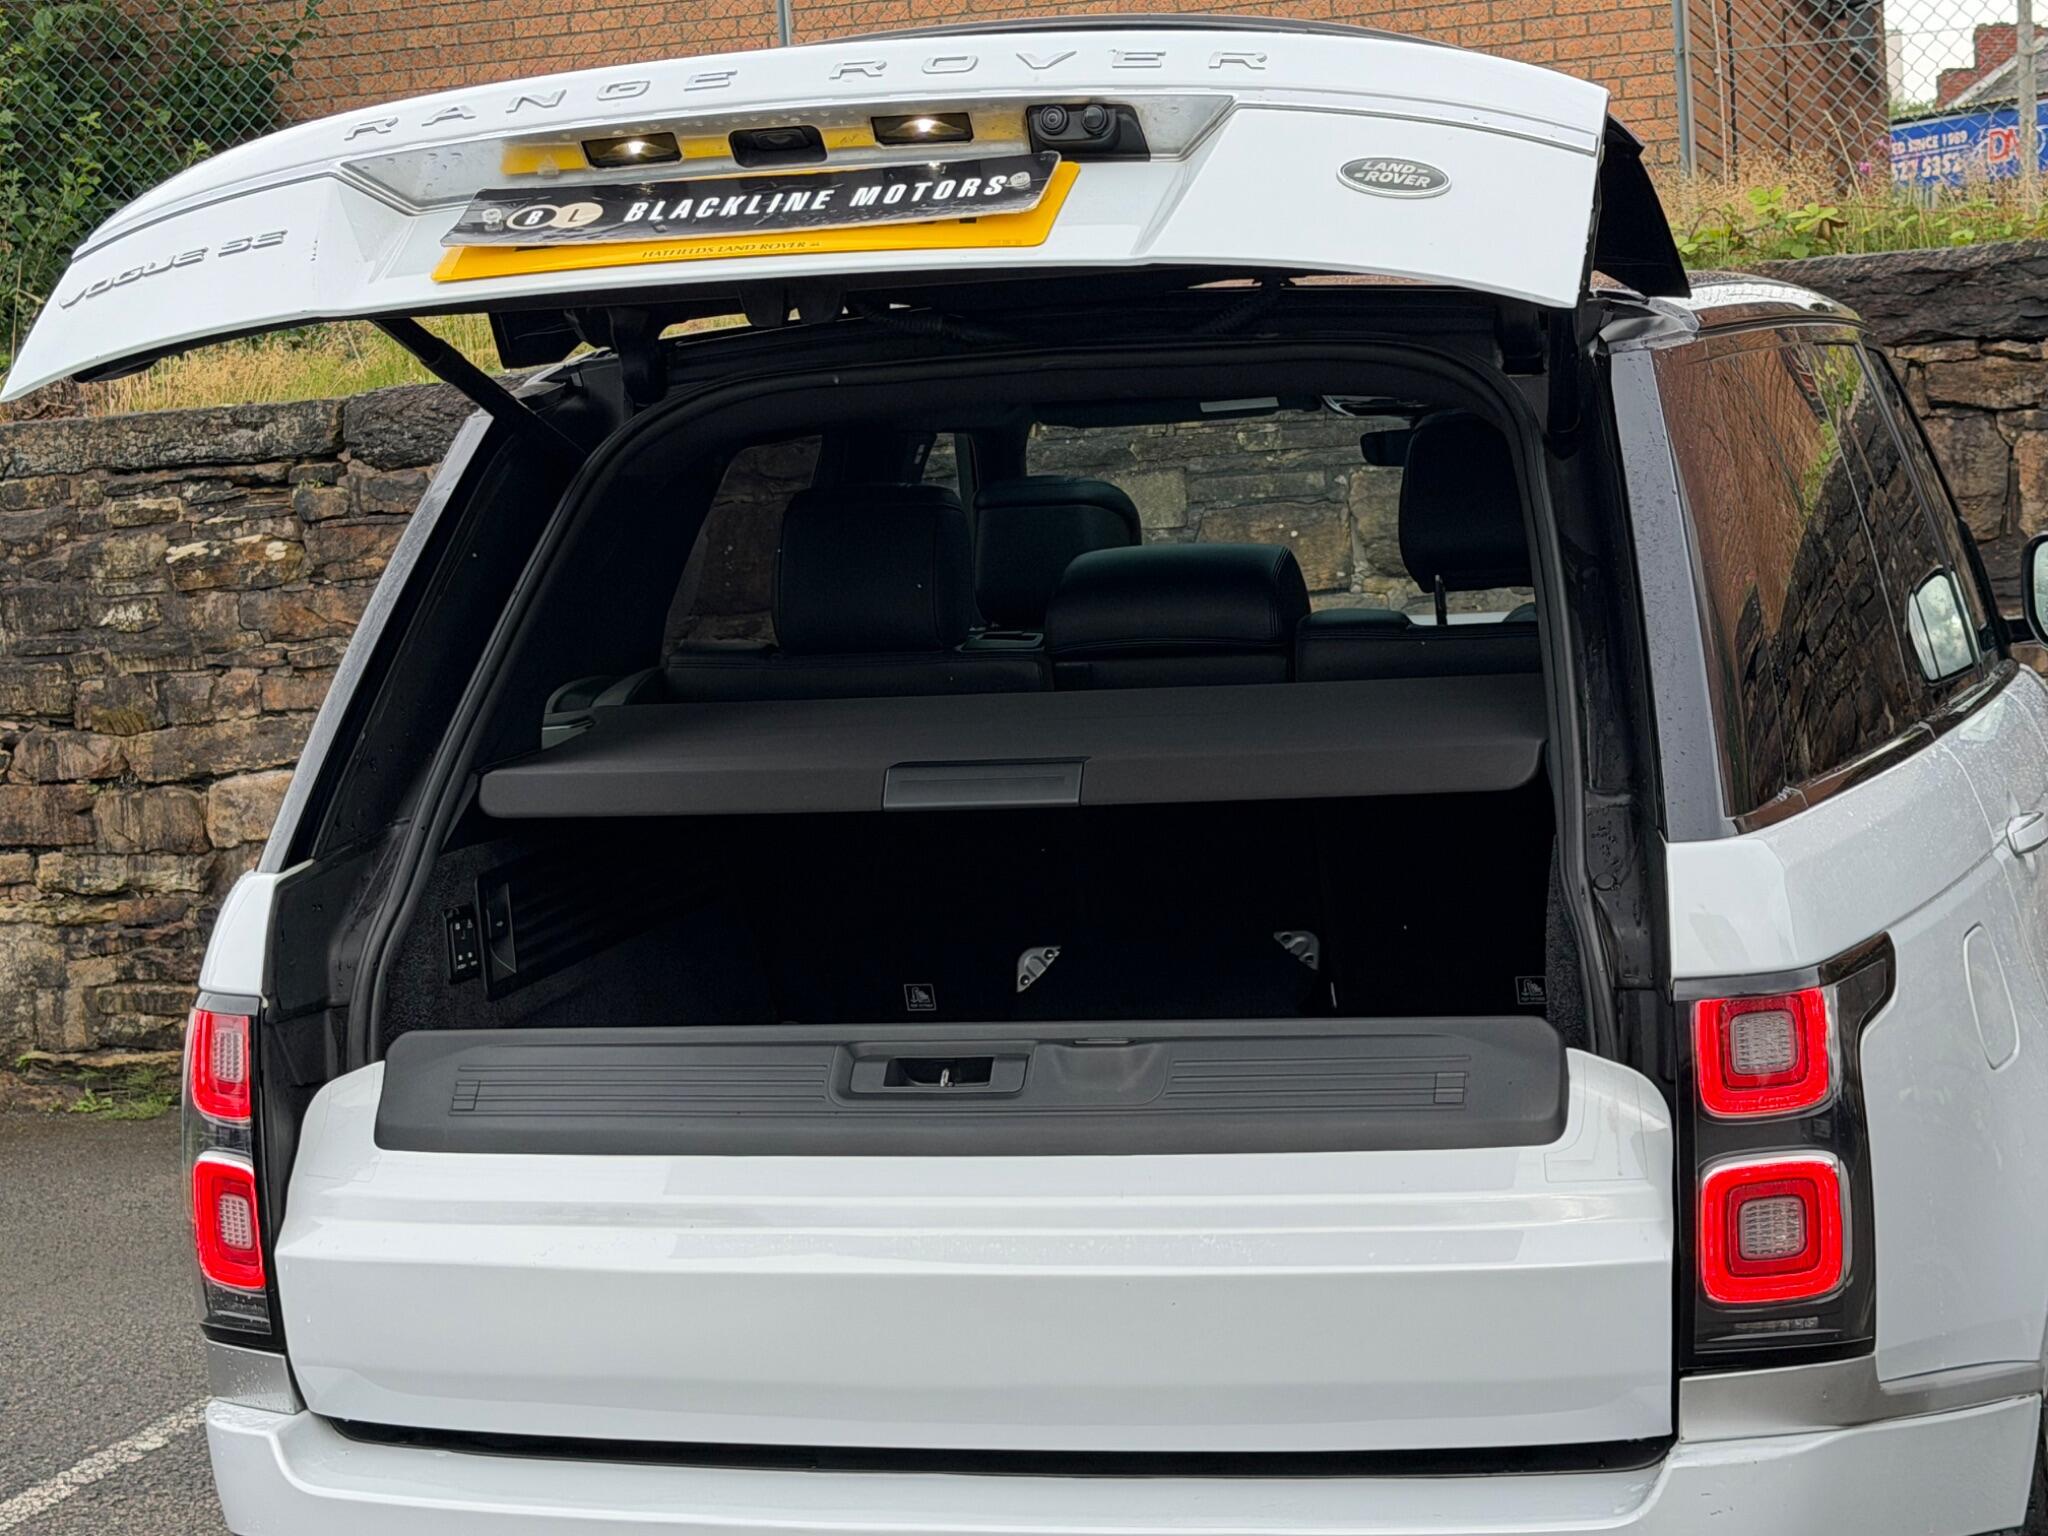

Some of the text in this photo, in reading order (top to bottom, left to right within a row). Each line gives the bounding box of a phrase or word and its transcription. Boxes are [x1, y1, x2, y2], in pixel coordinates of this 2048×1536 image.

[343, 49, 1268, 142] RANGE ROVER
[1361, 160, 1417, 174] LAND
[1363, 170, 1432, 188] ROVER
[624, 174, 1008, 223] BLACKLINE MOTORS
[524, 208, 581, 226] B L
[641, 246, 714, 258] HATFIELDS
[718, 243, 756, 253] LAND
[759, 241, 806, 250] ROVER
[59, 230, 288, 310] VOGUE SE
